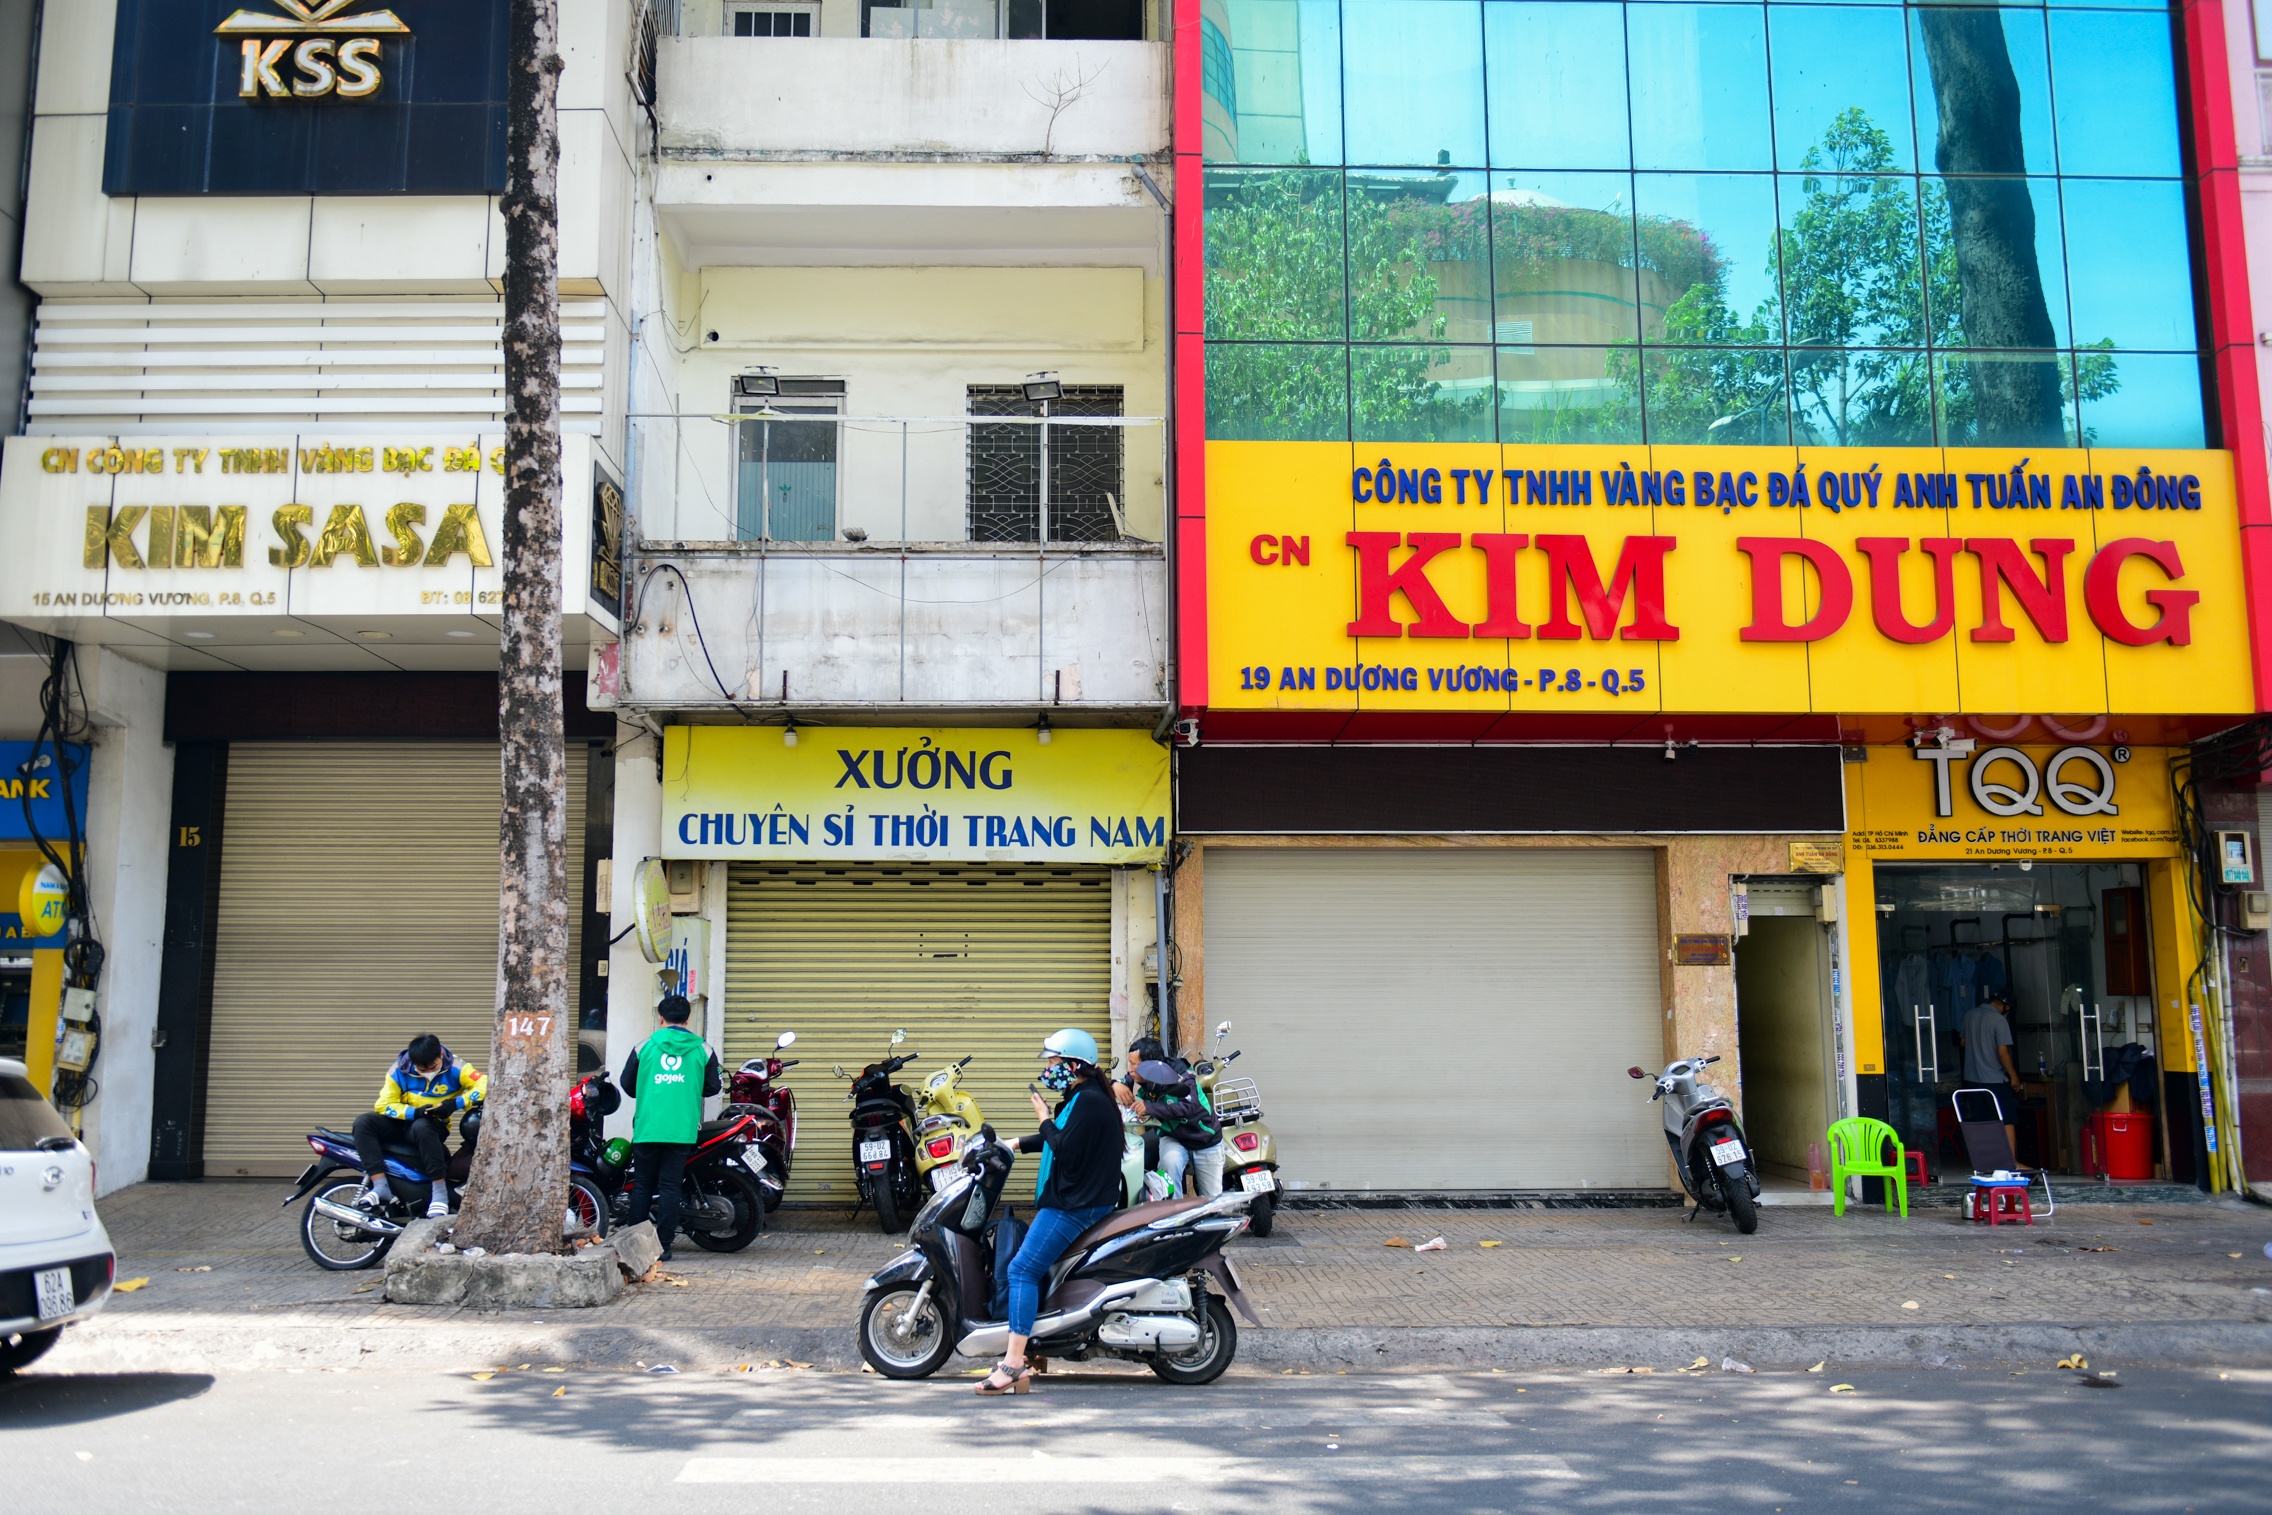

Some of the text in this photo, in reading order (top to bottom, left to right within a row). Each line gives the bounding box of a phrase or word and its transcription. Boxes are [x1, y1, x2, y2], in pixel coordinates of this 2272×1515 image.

[240, 38, 383, 98] KSS
[41, 447, 79, 474] CN
[86, 442, 163, 474] CÔNG
[173, 447, 209, 474] TY
[219, 447, 288, 474] TNHH
[299, 441, 374, 474] VÀNG
[382, 446, 434, 478] BẠC
[443, 441, 481, 473] ĐÁ
[1352, 458, 2201, 515] CÔNG TY TNHH VÀNG BẠC ĐÁ QUÝ ANH TUẤN AN ĐÔNG
[83, 503, 494, 569] KIM SASA
[1250, 533, 1310, 566] CN
[33, 592, 50, 606] 15
[54, 592, 77, 606] AN
[250, 591, 276, 606] Q.5
[454, 591, 471, 604] 08
[1345, 531, 2200, 647] KIM DUNG
[1240, 665, 1271, 691] 19
[1280, 666, 1315, 691] AN
[1325, 662, 1417, 692] DƯƠNG
[1428, 663, 1518, 692] VƯƠNG
[1539, 668, 1582, 692] P.8
[1601, 668, 1645, 698] Q.5
[834, 736, 1013, 790] XƯỞNG
[1914, 745, 2119, 818] TQQ
[178, 826, 200, 847] 15
[677, 802, 1166, 849] CHUYÊN SỈ THỜI TRANG NAM
[1917, 824, 2116, 844] ĐẲNG CẤP THỜI TRANG VIỆT
[508, 1016, 551, 1037] 147
[654, 1073, 685, 1084] gojek
[864, 1141, 886, 1151] 59-U2
[1715, 1142, 1737, 1155] 59-U2
[1717, 1150, 1743, 1164] 626.15
[1245, 1172, 1268, 1184] 59-U2
[44, 1271, 64, 1294] 62A
